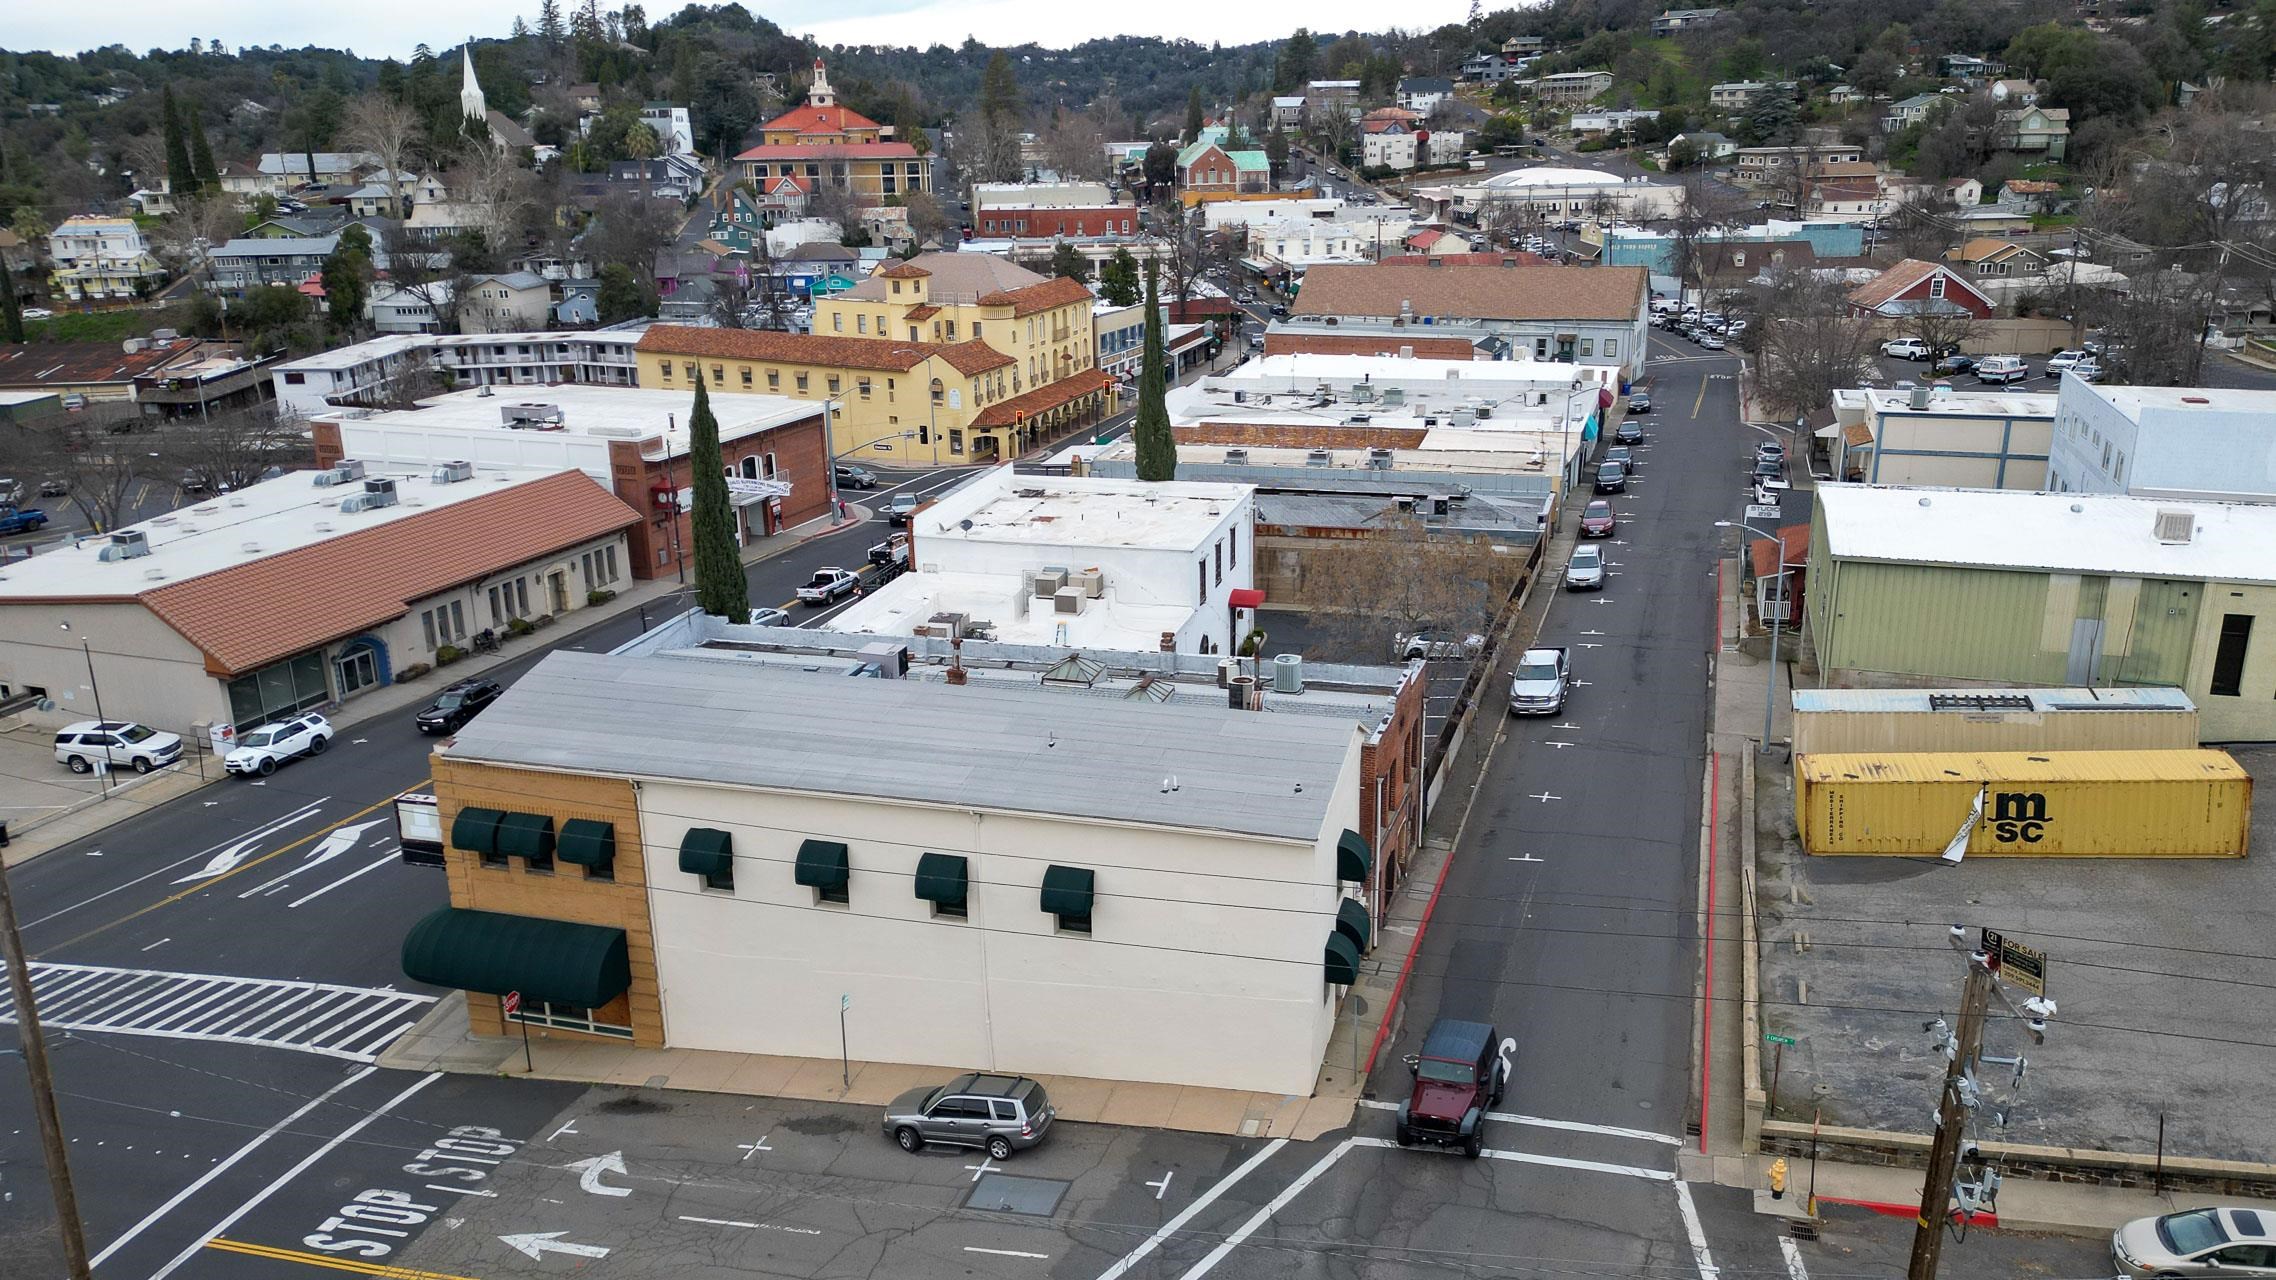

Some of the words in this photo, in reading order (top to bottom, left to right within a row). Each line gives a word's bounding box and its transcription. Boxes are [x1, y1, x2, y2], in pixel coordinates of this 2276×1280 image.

[1989, 933, 1998, 941] 21
[2003, 938, 2020, 951] FOR
[2022, 946, 2044, 961] SALE
[505, 995, 518, 1010] STOP
[303, 1189, 438, 1256] STOP
